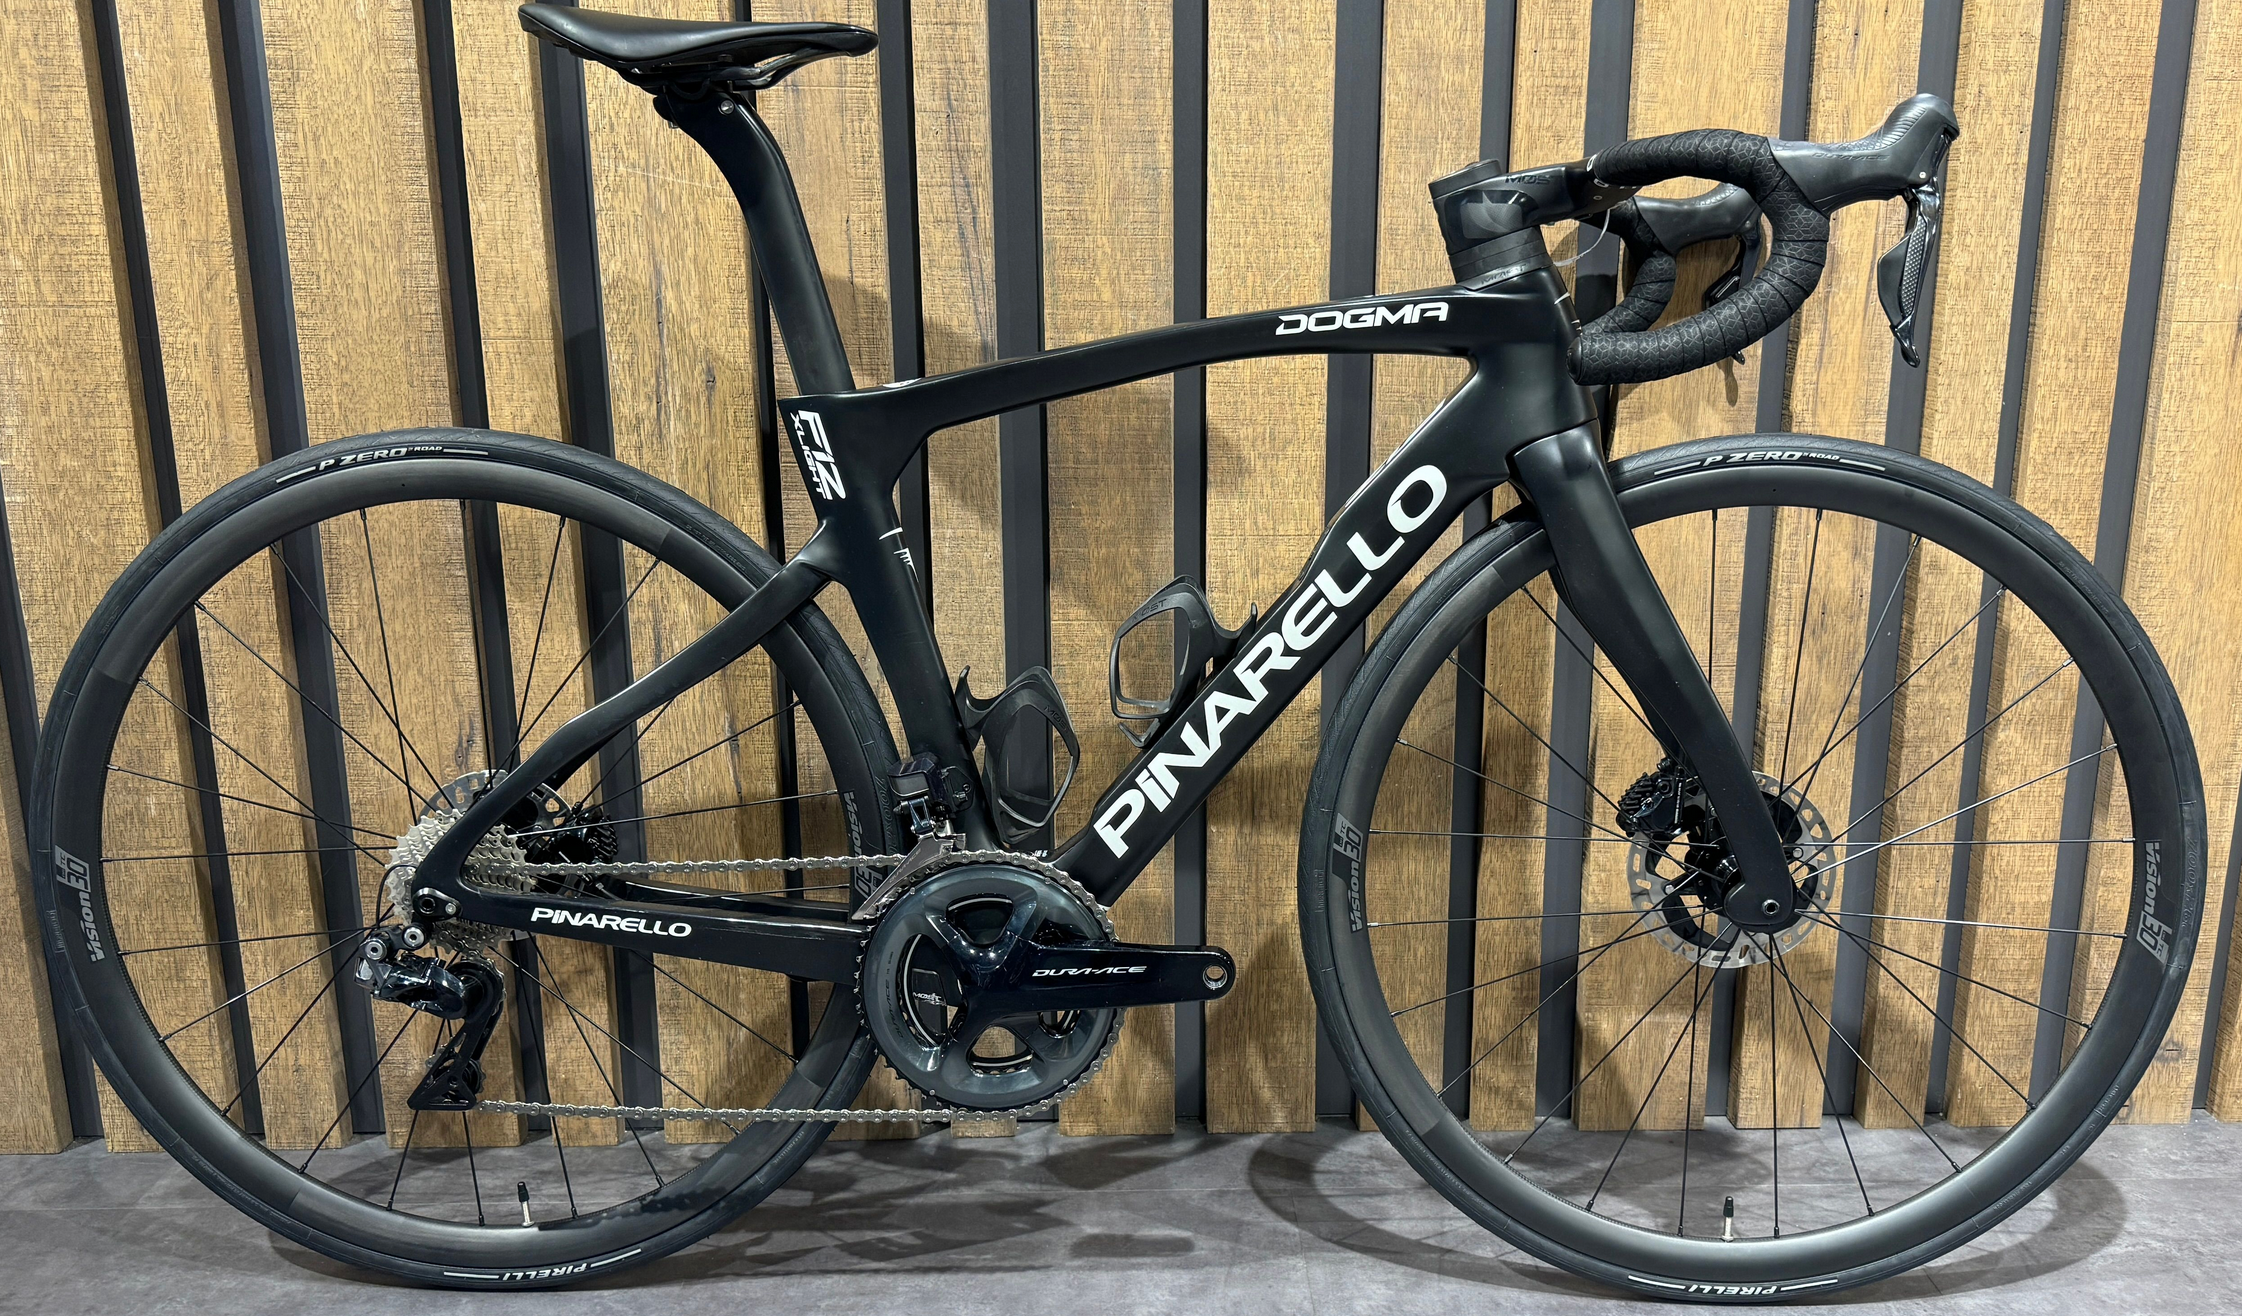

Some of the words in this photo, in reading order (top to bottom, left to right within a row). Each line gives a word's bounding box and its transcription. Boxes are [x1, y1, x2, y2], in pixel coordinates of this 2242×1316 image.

[1275, 301, 1449, 336] DOGMA
[318, 459, 336, 471] P
[339, 447, 408, 466] ZERO
[798, 409, 847, 501] F12
[1702, 455, 1724, 467] P
[1726, 451, 1804, 464] ZERO
[1094, 464, 1448, 859] PINARELLO
[530, 907, 693, 938] PINARELLO
[1031, 965, 1148, 977] DURA-ACE
[502, 1262, 588, 1281] PIRELLI
[1687, 1284, 1778, 1295] PIRELLI
